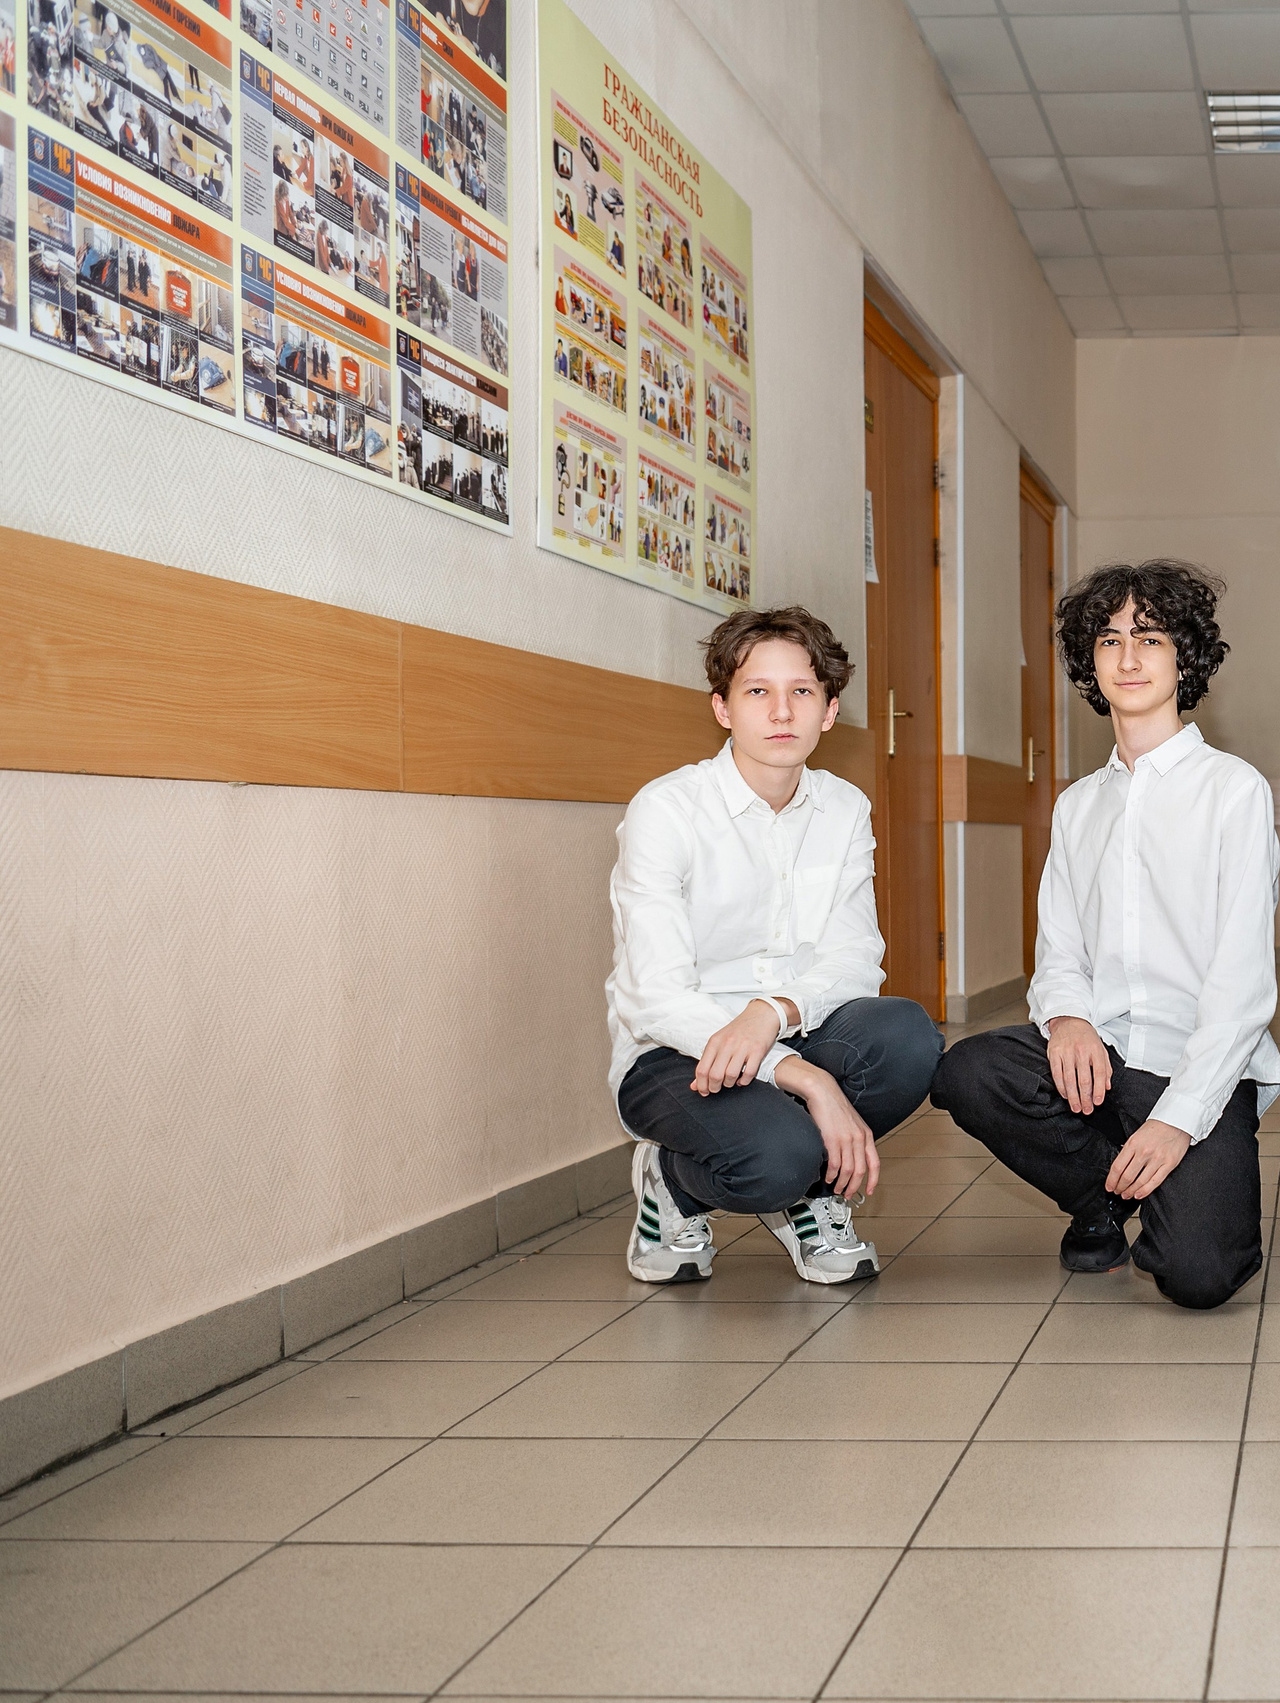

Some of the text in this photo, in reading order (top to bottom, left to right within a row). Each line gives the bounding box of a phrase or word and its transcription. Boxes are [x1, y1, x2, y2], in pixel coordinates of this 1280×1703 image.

[172, 6, 201, 37] ГОРЕНИЯ
[409, 10, 419, 32] ЧС
[257, 65, 270, 92] ЧС
[274, 80, 296, 106] ПЕРВАЯ
[297, 94, 321, 124] ПОМОЩЬ
[322, 114, 333, 132] ПРИ
[333, 122, 354, 147] ОЖОГАХ
[603, 63, 700, 185] ГРАЖДАНСКАЯ
[54, 141, 71, 174] ЧС
[602, 97, 703, 218] БЕЗОПАСНОСТЬ
[77, 160, 113, 194] УСЛОВИЯ
[113, 180, 172, 225] ВОЗНИКНОВЕНИЯ
[172, 213, 200, 240] ПОЖАРА
[409, 174, 418, 198] ЧС
[259, 256, 272, 283] ЧС
[276, 269, 302, 294] УСЛОВИЯ
[410, 338, 420, 360] ЧС
